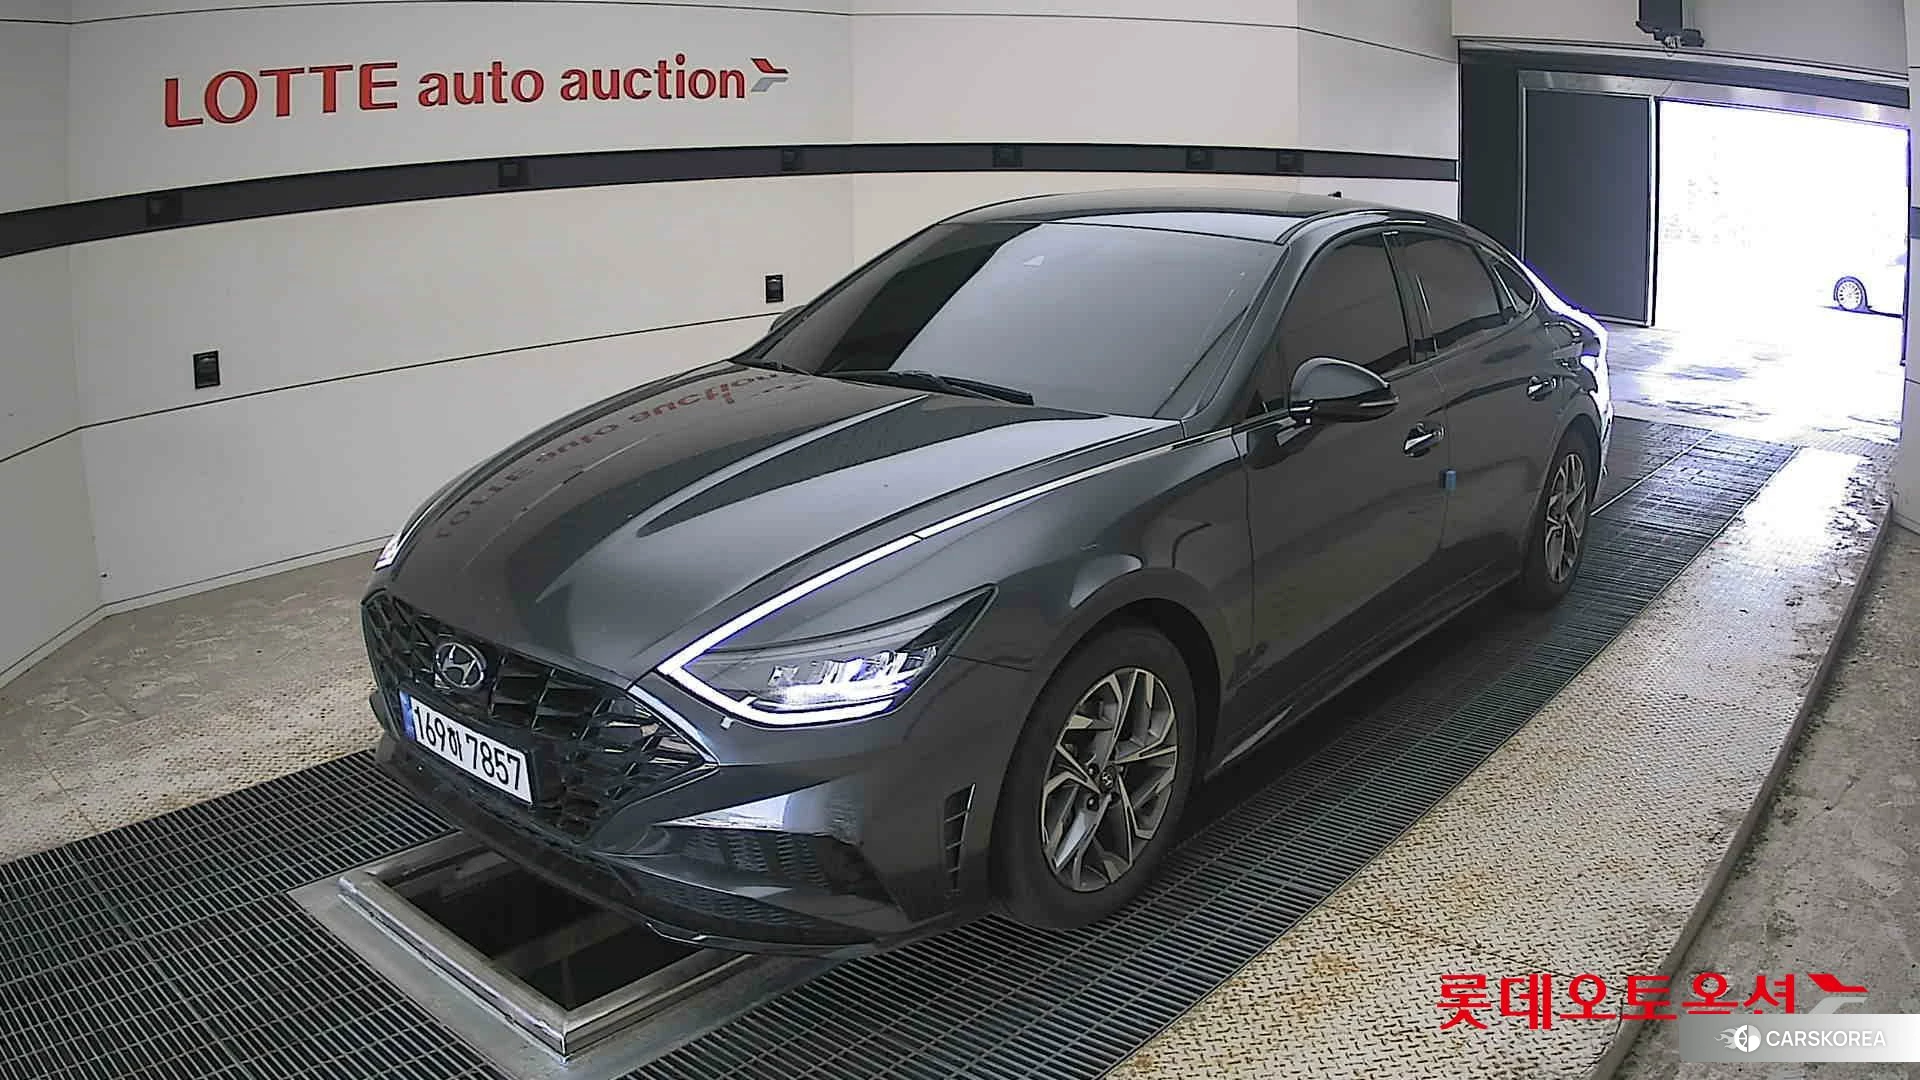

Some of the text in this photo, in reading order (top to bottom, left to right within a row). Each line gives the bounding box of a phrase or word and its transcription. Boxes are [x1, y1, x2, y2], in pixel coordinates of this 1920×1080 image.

[163, 54, 746, 128] LOTTE auto auction
[465, 733, 521, 791] 7857
